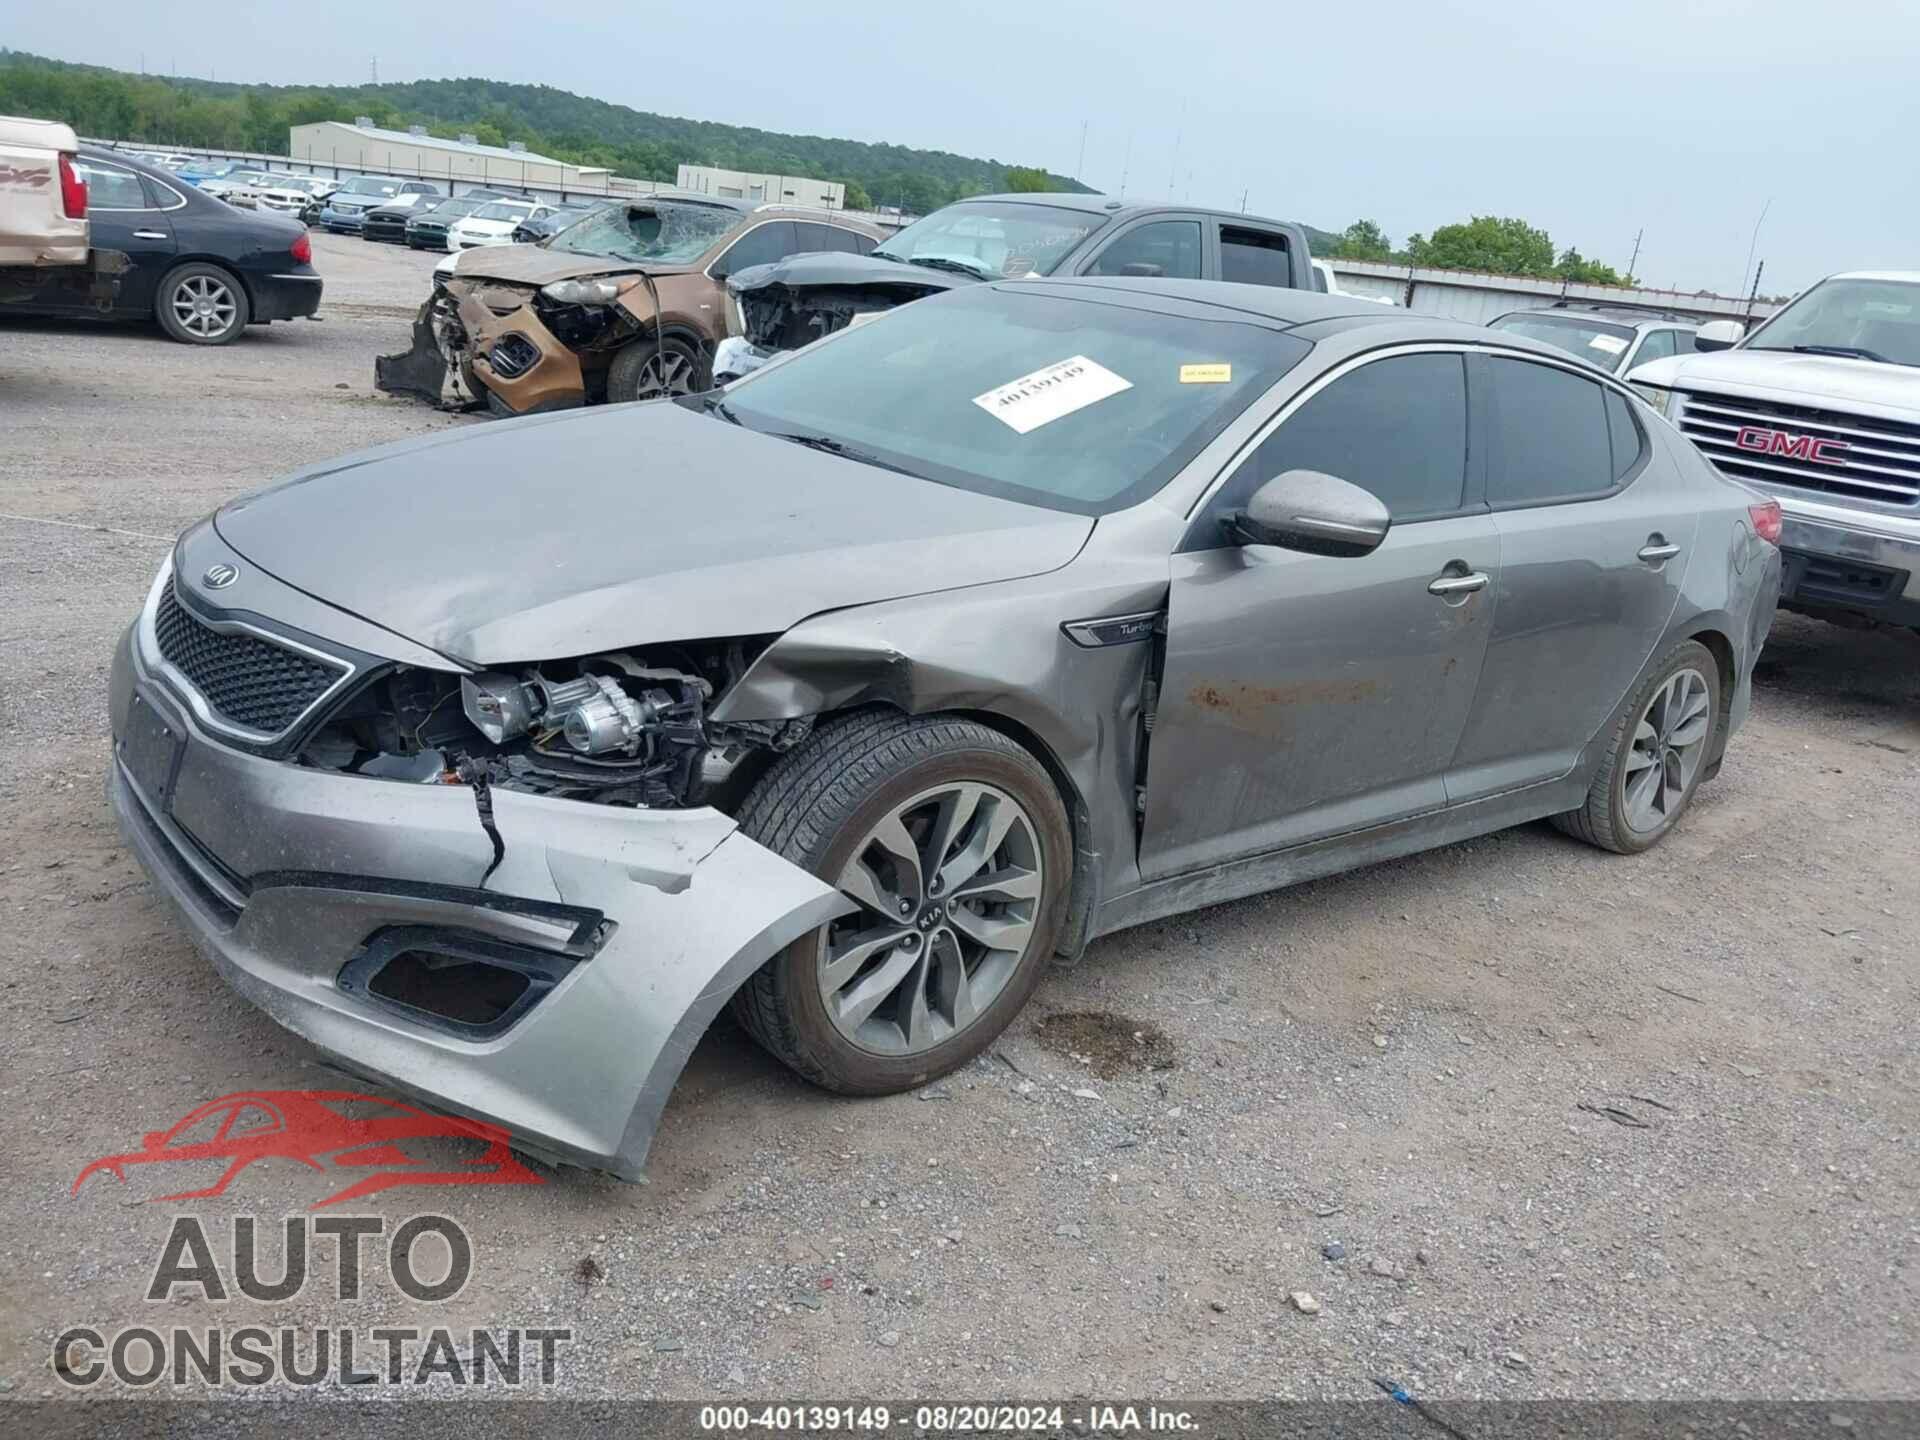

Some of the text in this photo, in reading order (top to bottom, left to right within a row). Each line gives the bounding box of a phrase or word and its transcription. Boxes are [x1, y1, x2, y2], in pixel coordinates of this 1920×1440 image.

[998, 366, 1084, 407] 40139149
[1737, 426, 1851, 465] GMC
[1120, 622, 1152, 634] Turbo
